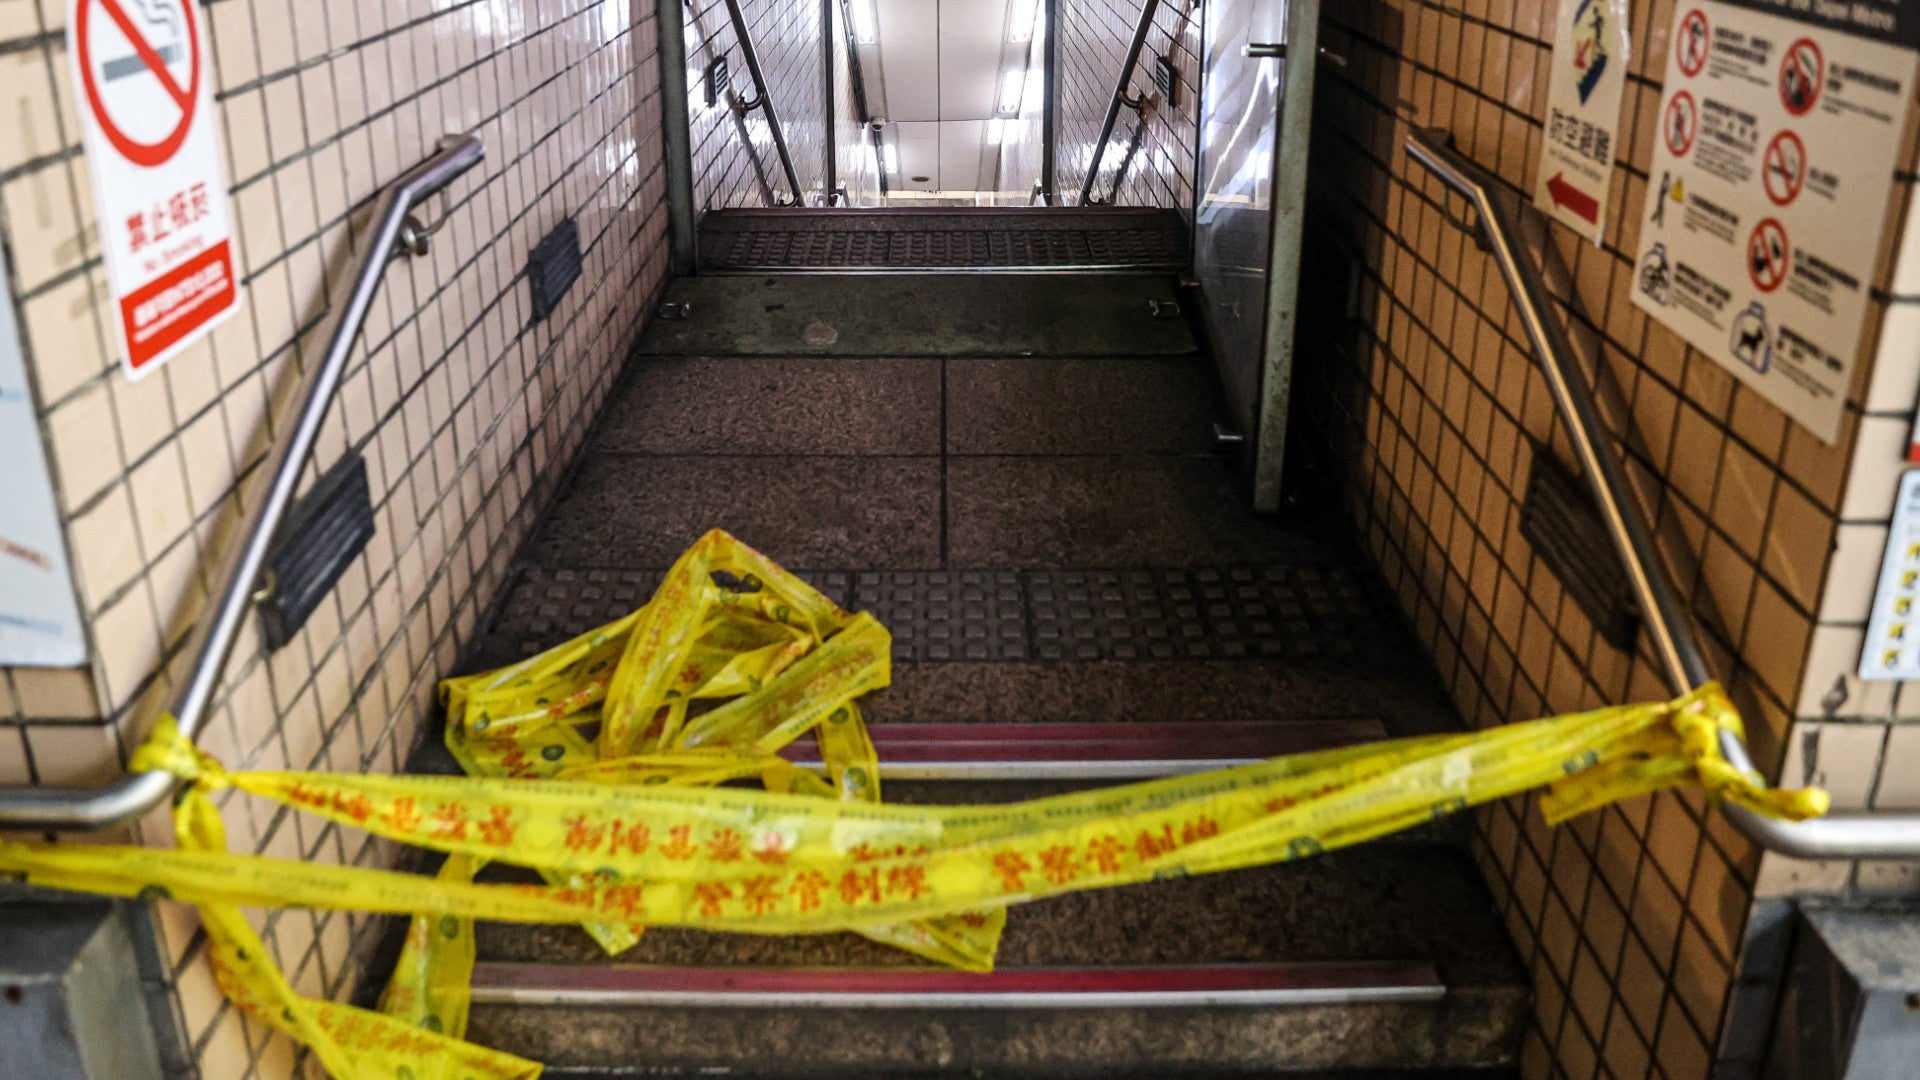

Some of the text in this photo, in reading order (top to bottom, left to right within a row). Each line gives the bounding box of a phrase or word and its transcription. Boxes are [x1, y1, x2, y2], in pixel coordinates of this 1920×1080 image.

[694, 864, 932, 917] 警察管制線
